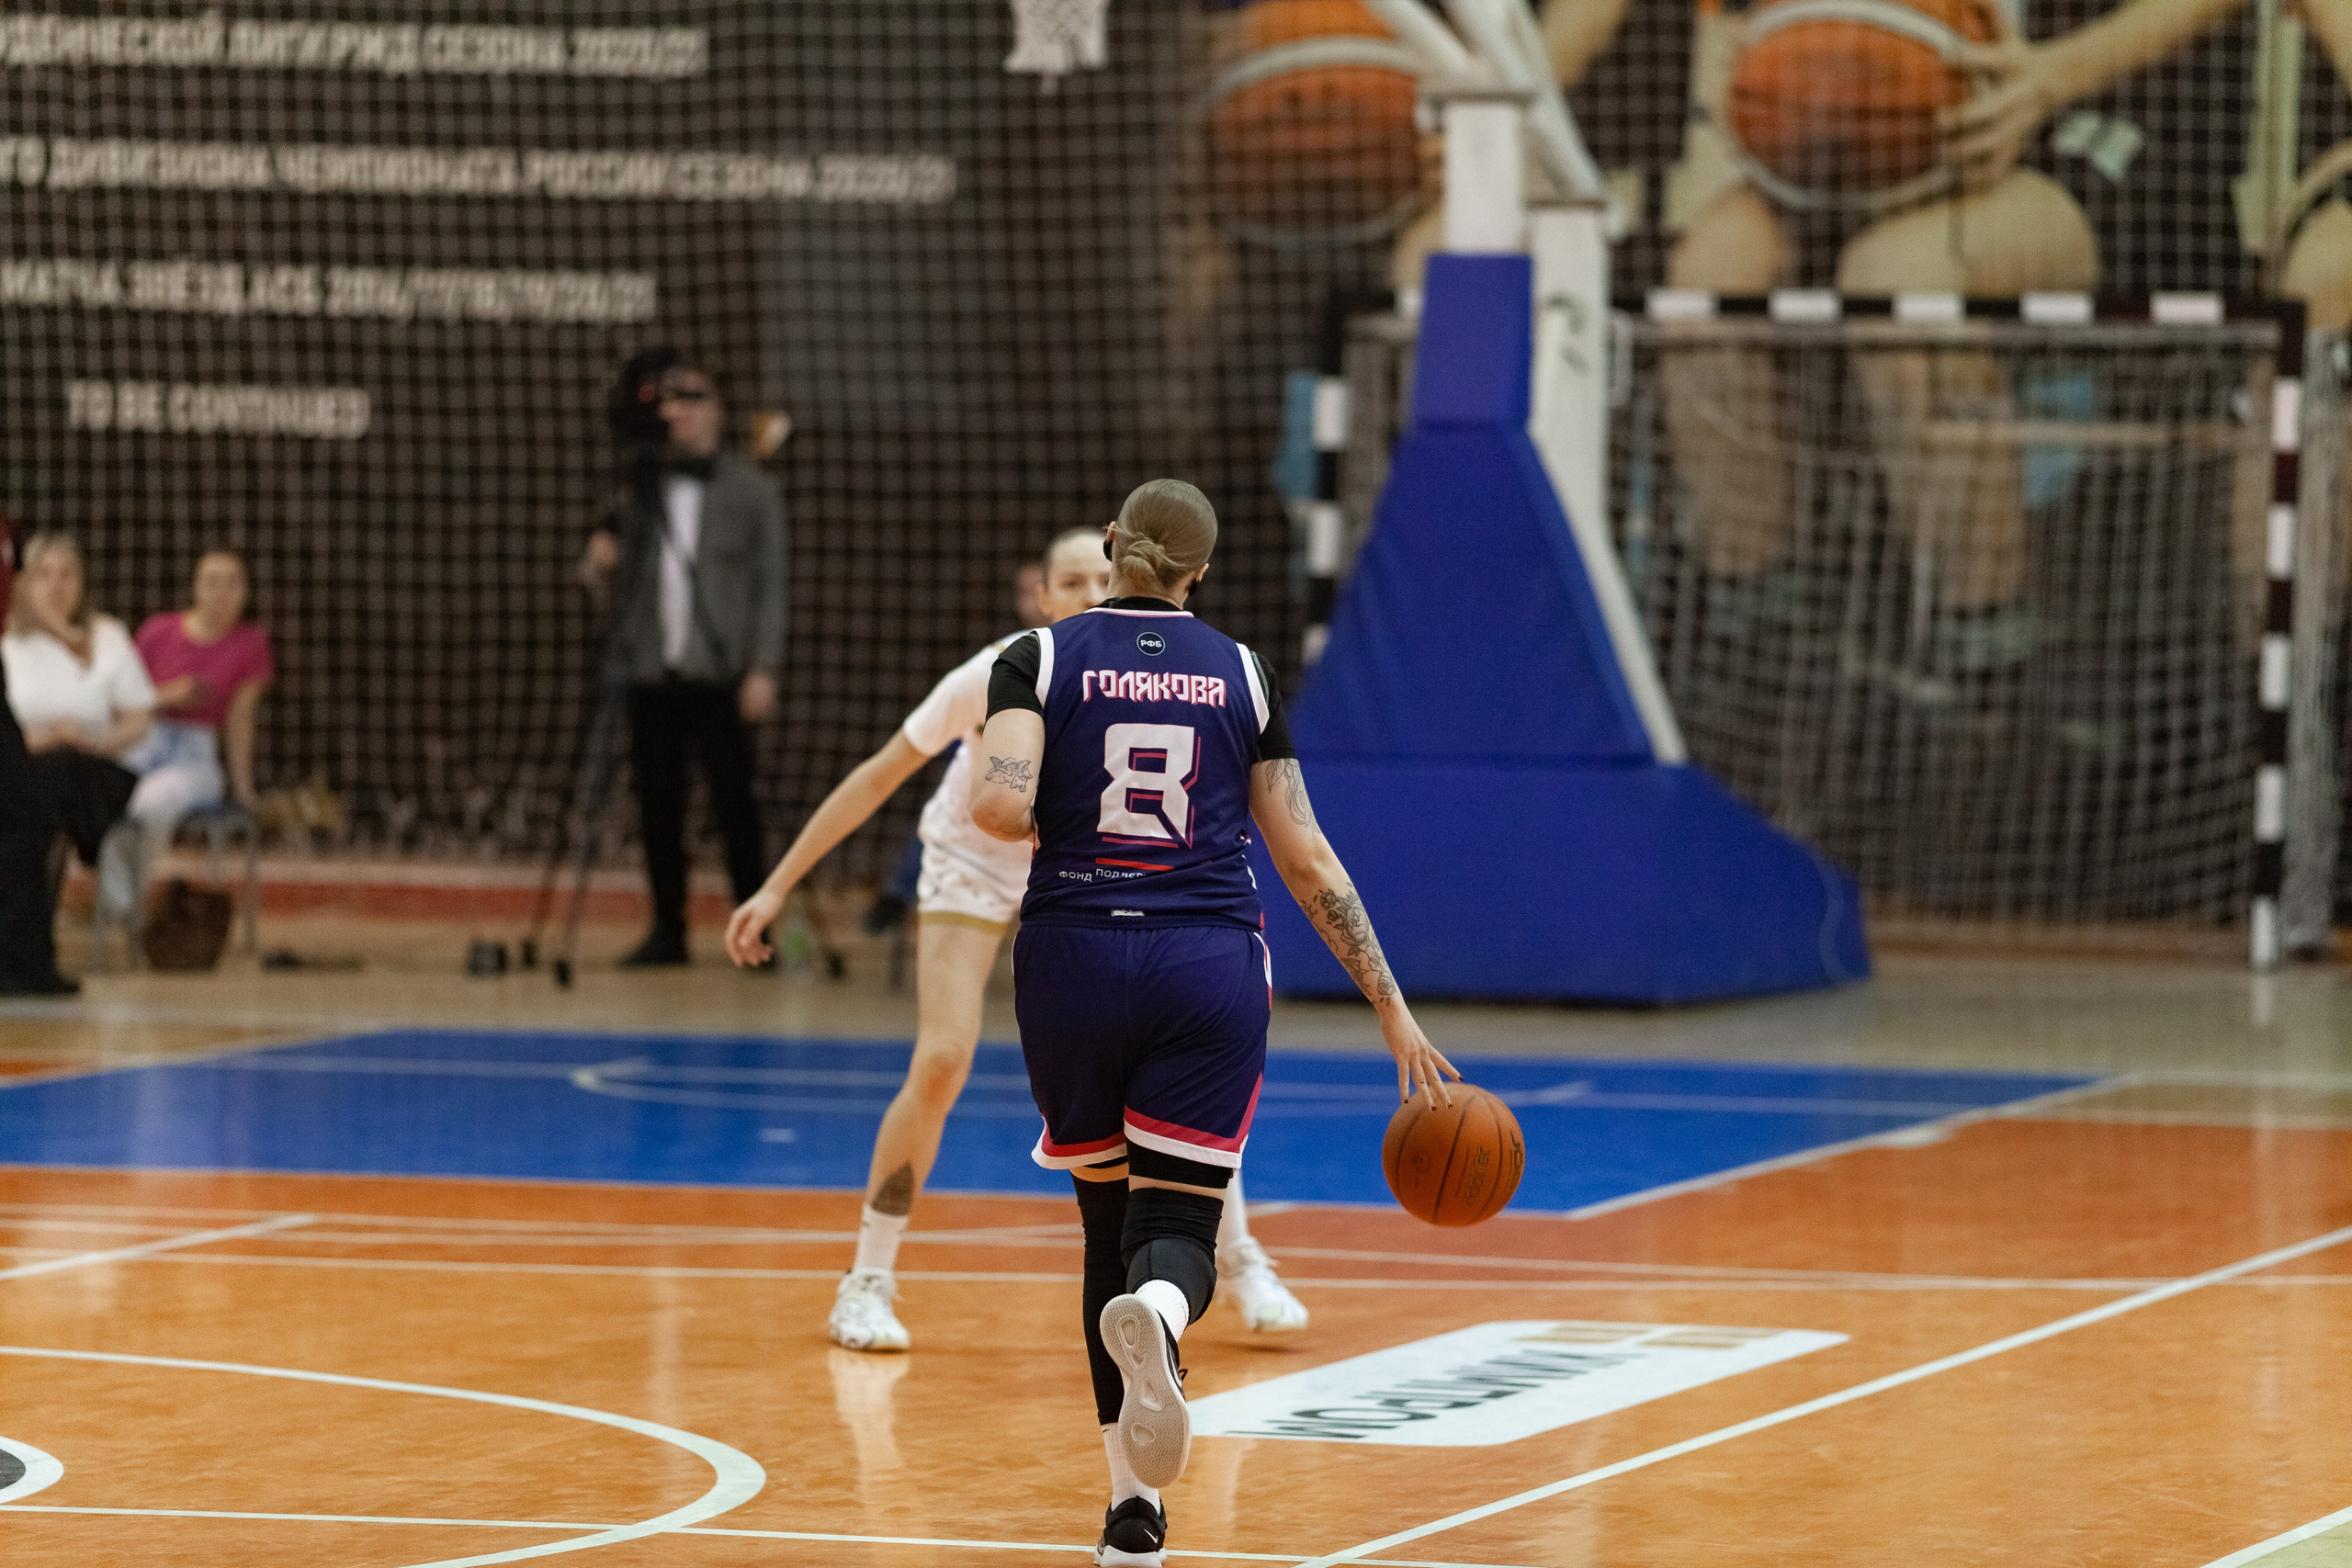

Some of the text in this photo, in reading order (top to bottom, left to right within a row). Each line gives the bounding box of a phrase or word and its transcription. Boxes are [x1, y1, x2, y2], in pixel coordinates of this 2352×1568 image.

[168, 383, 371, 439] CONTINUED
[1140, 639, 1162, 649] РФБ
[1082, 670, 1227, 708] ГОЛЯКОВА
[1097, 722, 1197, 845] 8
[1058, 870, 1092, 883] ФОНД
